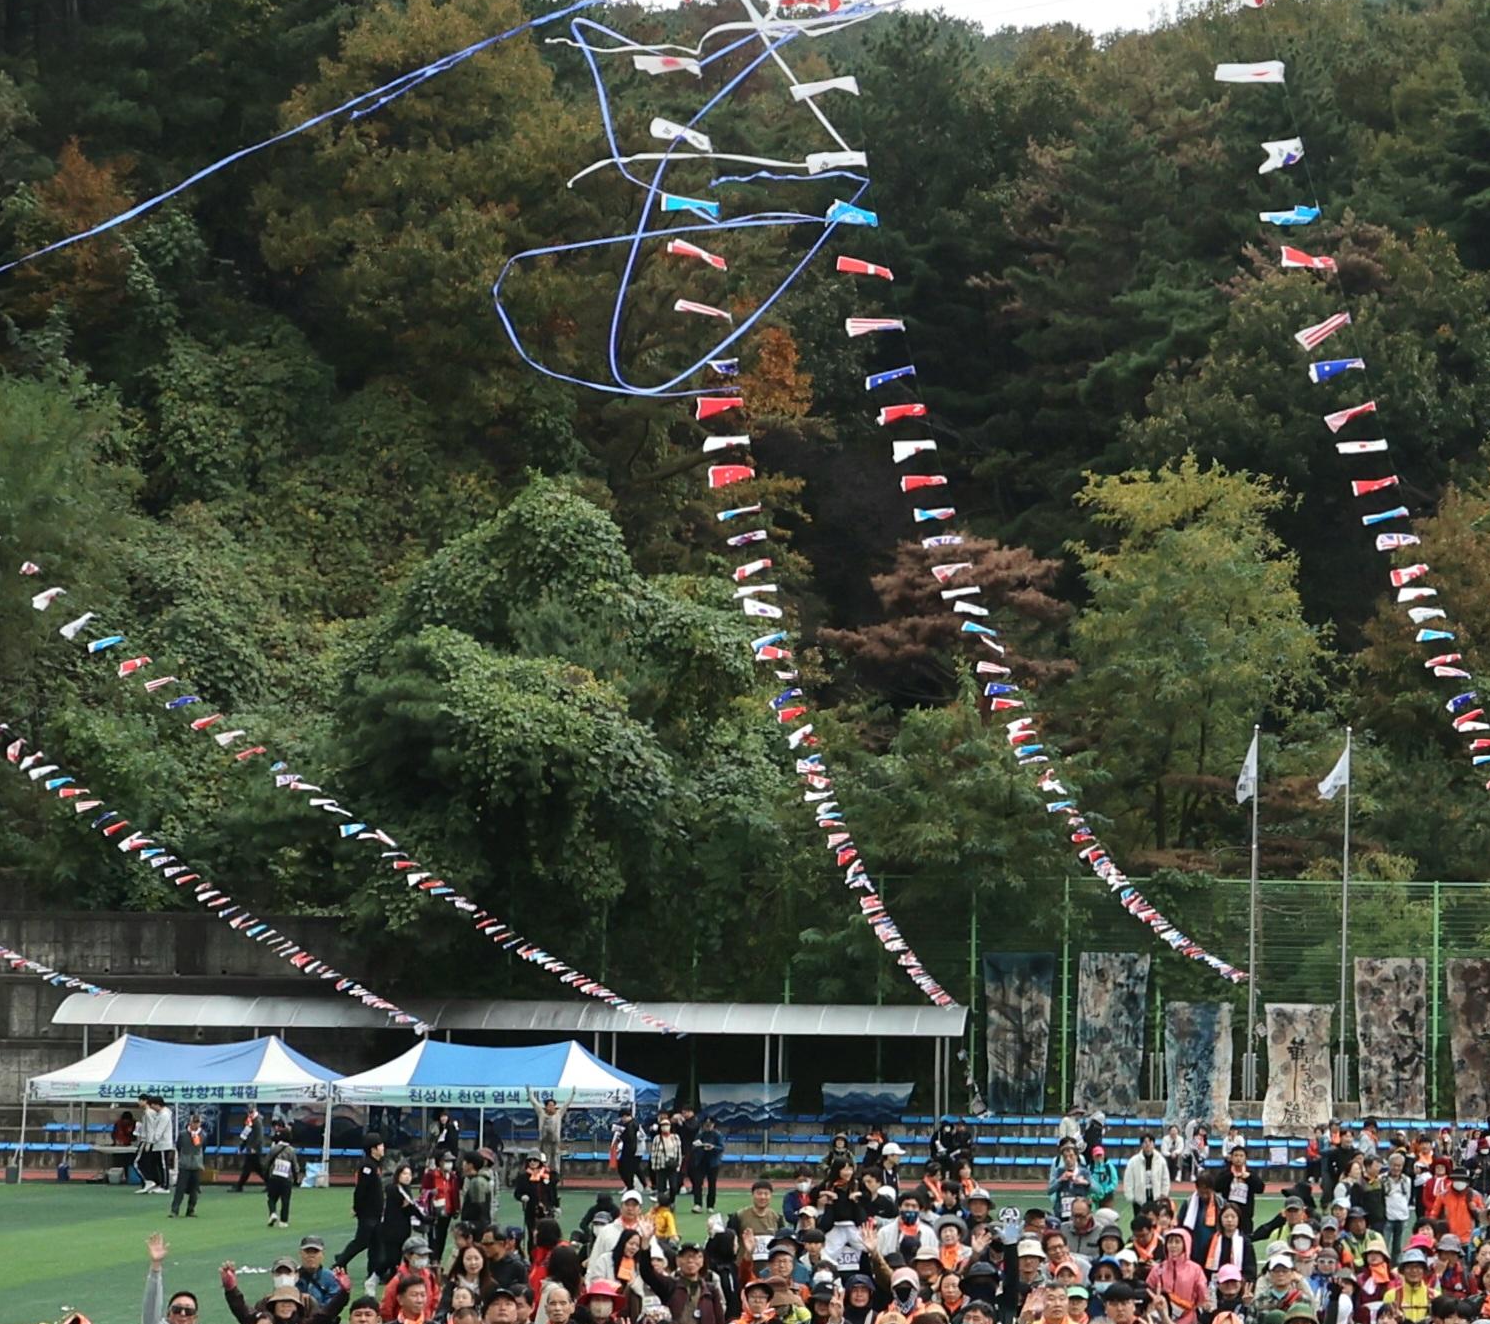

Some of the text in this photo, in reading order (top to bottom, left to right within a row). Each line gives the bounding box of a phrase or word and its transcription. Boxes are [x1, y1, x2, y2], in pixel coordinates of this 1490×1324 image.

[98, 1084, 259, 1100] 천성산 천연 방향제 체험
[409, 1088, 452, 1103] 천성산
[457, 1088, 486, 1104] 천연
[491, 1088, 521, 1104] 염색
